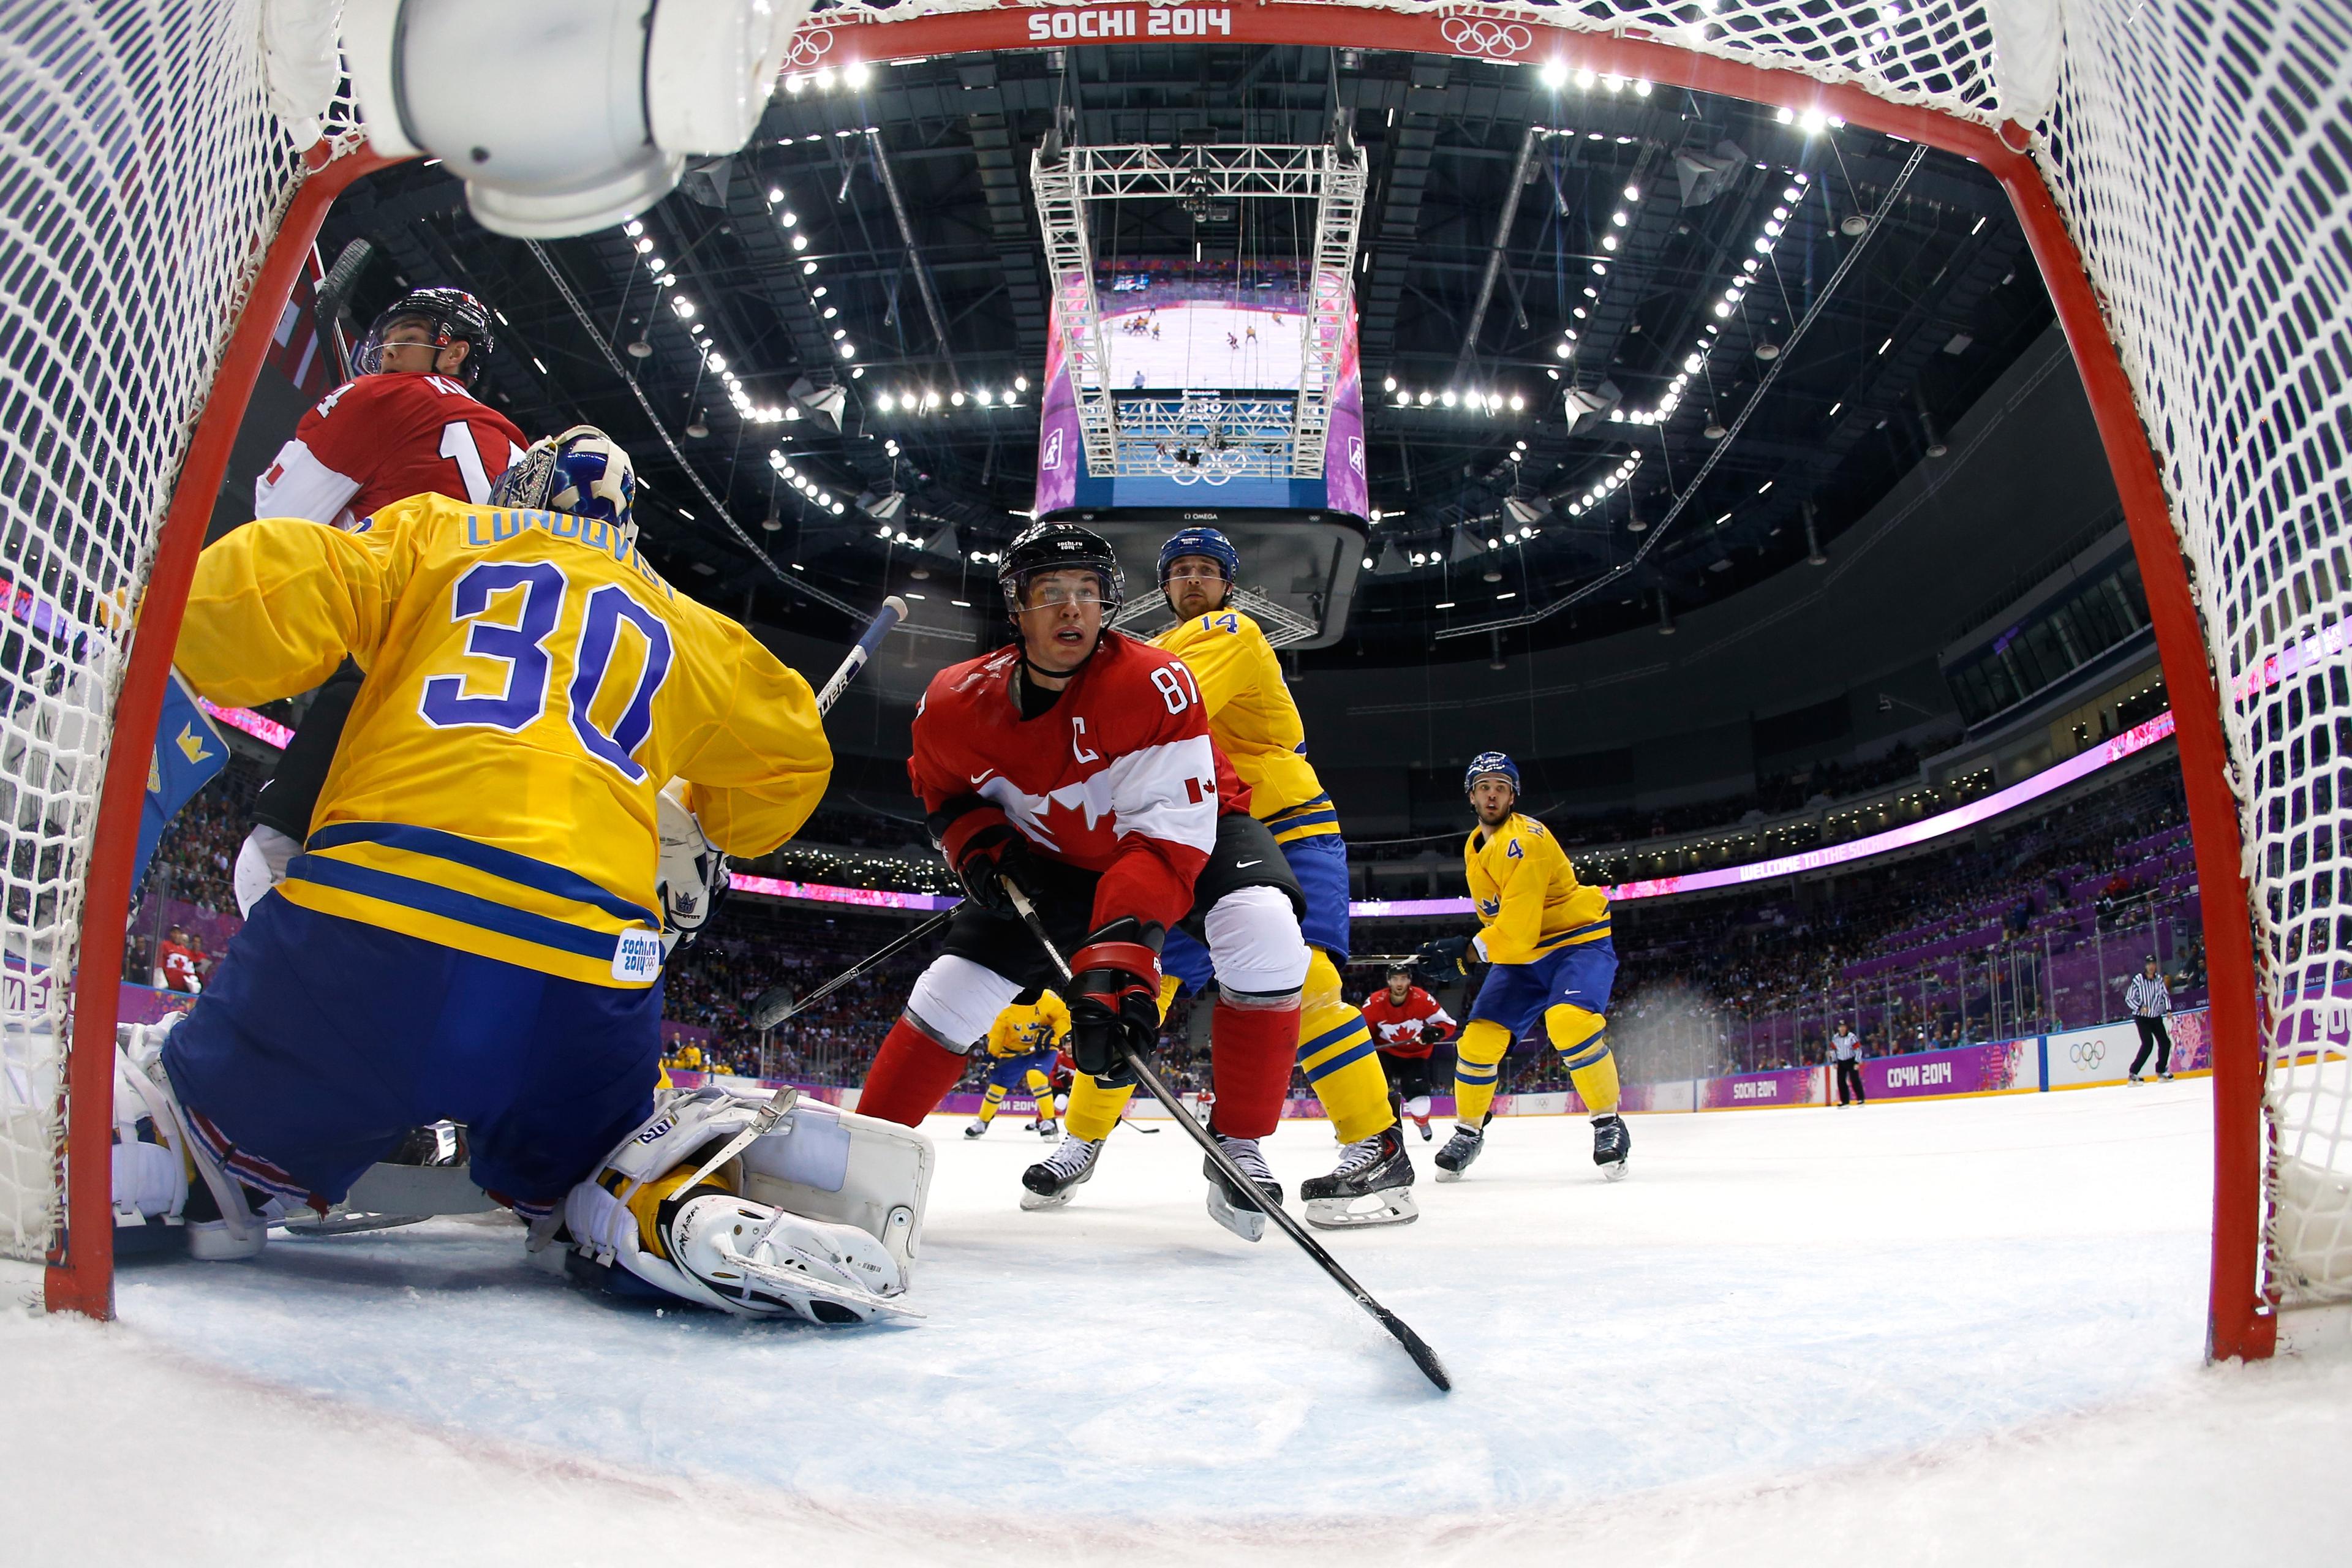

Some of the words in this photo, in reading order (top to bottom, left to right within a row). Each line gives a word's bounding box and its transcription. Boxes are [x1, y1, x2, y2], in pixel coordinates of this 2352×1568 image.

[1028, 10, 1136, 40] SOCHI
[1148, 9, 1230, 36] 2014
[437, 421, 492, 505] 1
[1200, 614, 1238, 635] 14
[418, 560, 675, 785] 30
[1150, 662, 1198, 715] 87
[1072, 717, 1099, 764] C
[1506, 838, 1525, 859] 4
[1740, 856, 1801, 881] WELCOME
[1803, 852, 1819, 869] TO
[1822, 848, 1847, 865] THE
[621, 937, 657, 956] sochi.ru
[625, 956, 644, 975] 2014
[1888, 1066, 1919, 1088] СОЧИ
[1921, 1062, 1951, 1086] 2014
[1733, 1082, 1755, 1099] SOCHI
[1757, 1080, 1776, 1098] 2014
[1012, 1101, 1038, 1111] 2014
